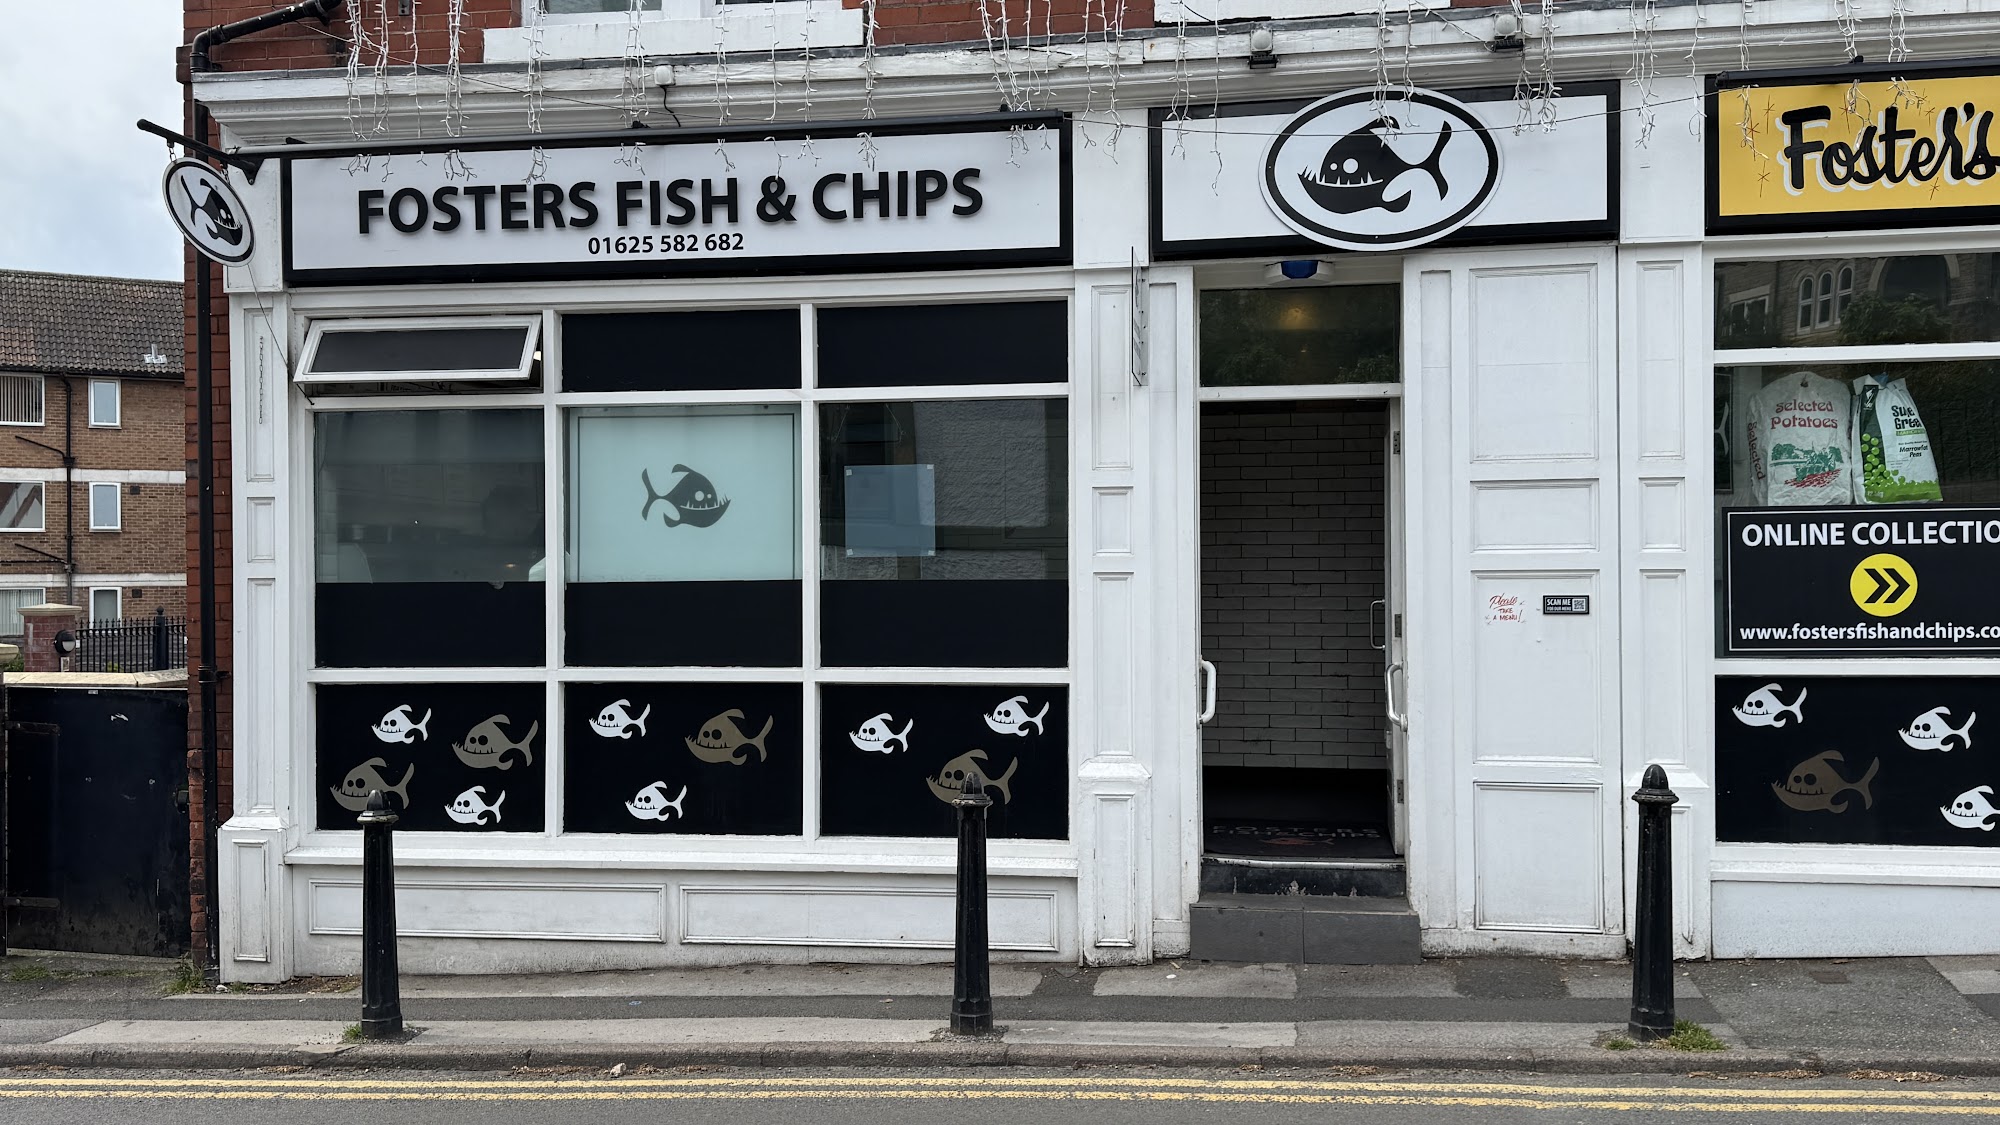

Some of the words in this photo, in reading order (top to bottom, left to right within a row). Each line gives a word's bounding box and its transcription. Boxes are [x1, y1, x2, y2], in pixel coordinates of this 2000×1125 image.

[1780, 102, 2000, 191] Foster's
[358, 181, 599, 234] FOSTERS
[616, 178, 739, 227] FISH
[756, 175, 797, 223] &
[812, 168, 984, 220] CHIPS
[588, 236, 654, 255] 01625
[660, 234, 699, 253] 582
[704, 232, 744, 251] 682
[1891, 405, 1915, 417] Sue
[1742, 523, 1845, 546] ONLINE
[1851, 520, 2000, 545] COLLECTIO
[1547, 598, 1561, 606] SCAN
[1562, 598, 1571, 606] ME
[1740, 622, 2000, 643] www.fostersfishandchips.co
